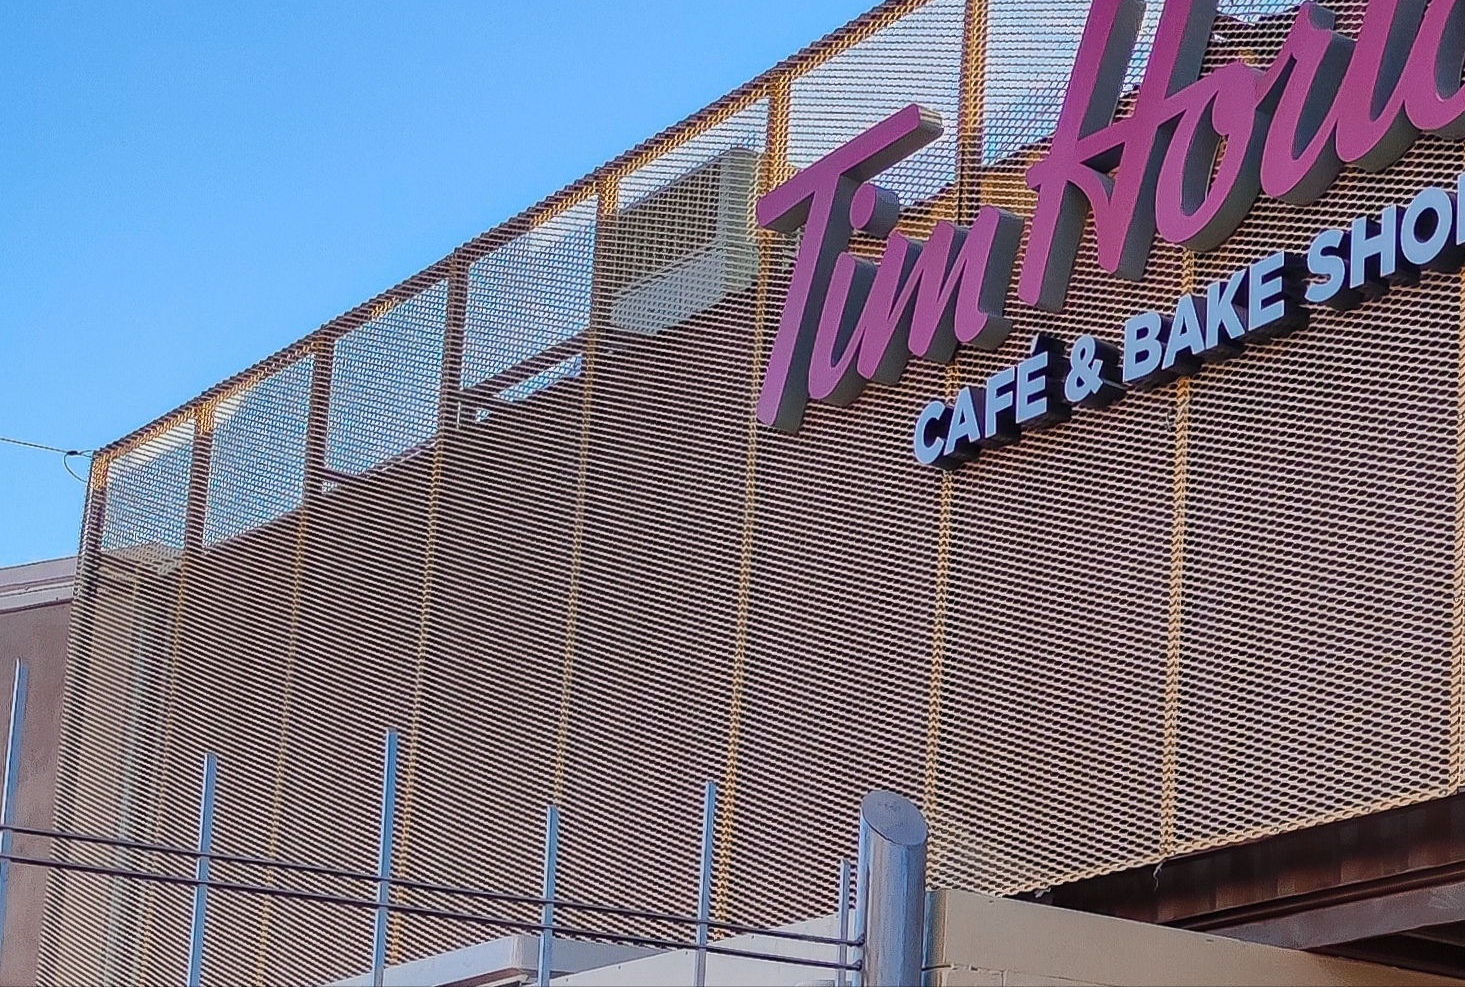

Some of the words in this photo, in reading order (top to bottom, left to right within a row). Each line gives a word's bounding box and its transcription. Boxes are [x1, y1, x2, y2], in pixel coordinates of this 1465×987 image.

[757, 103, 1010, 427] Tim
[912, 334, 1051, 467] CAFÉ
[1064, 335, 1105, 402] &
[1122, 250, 1288, 383] BAKE
